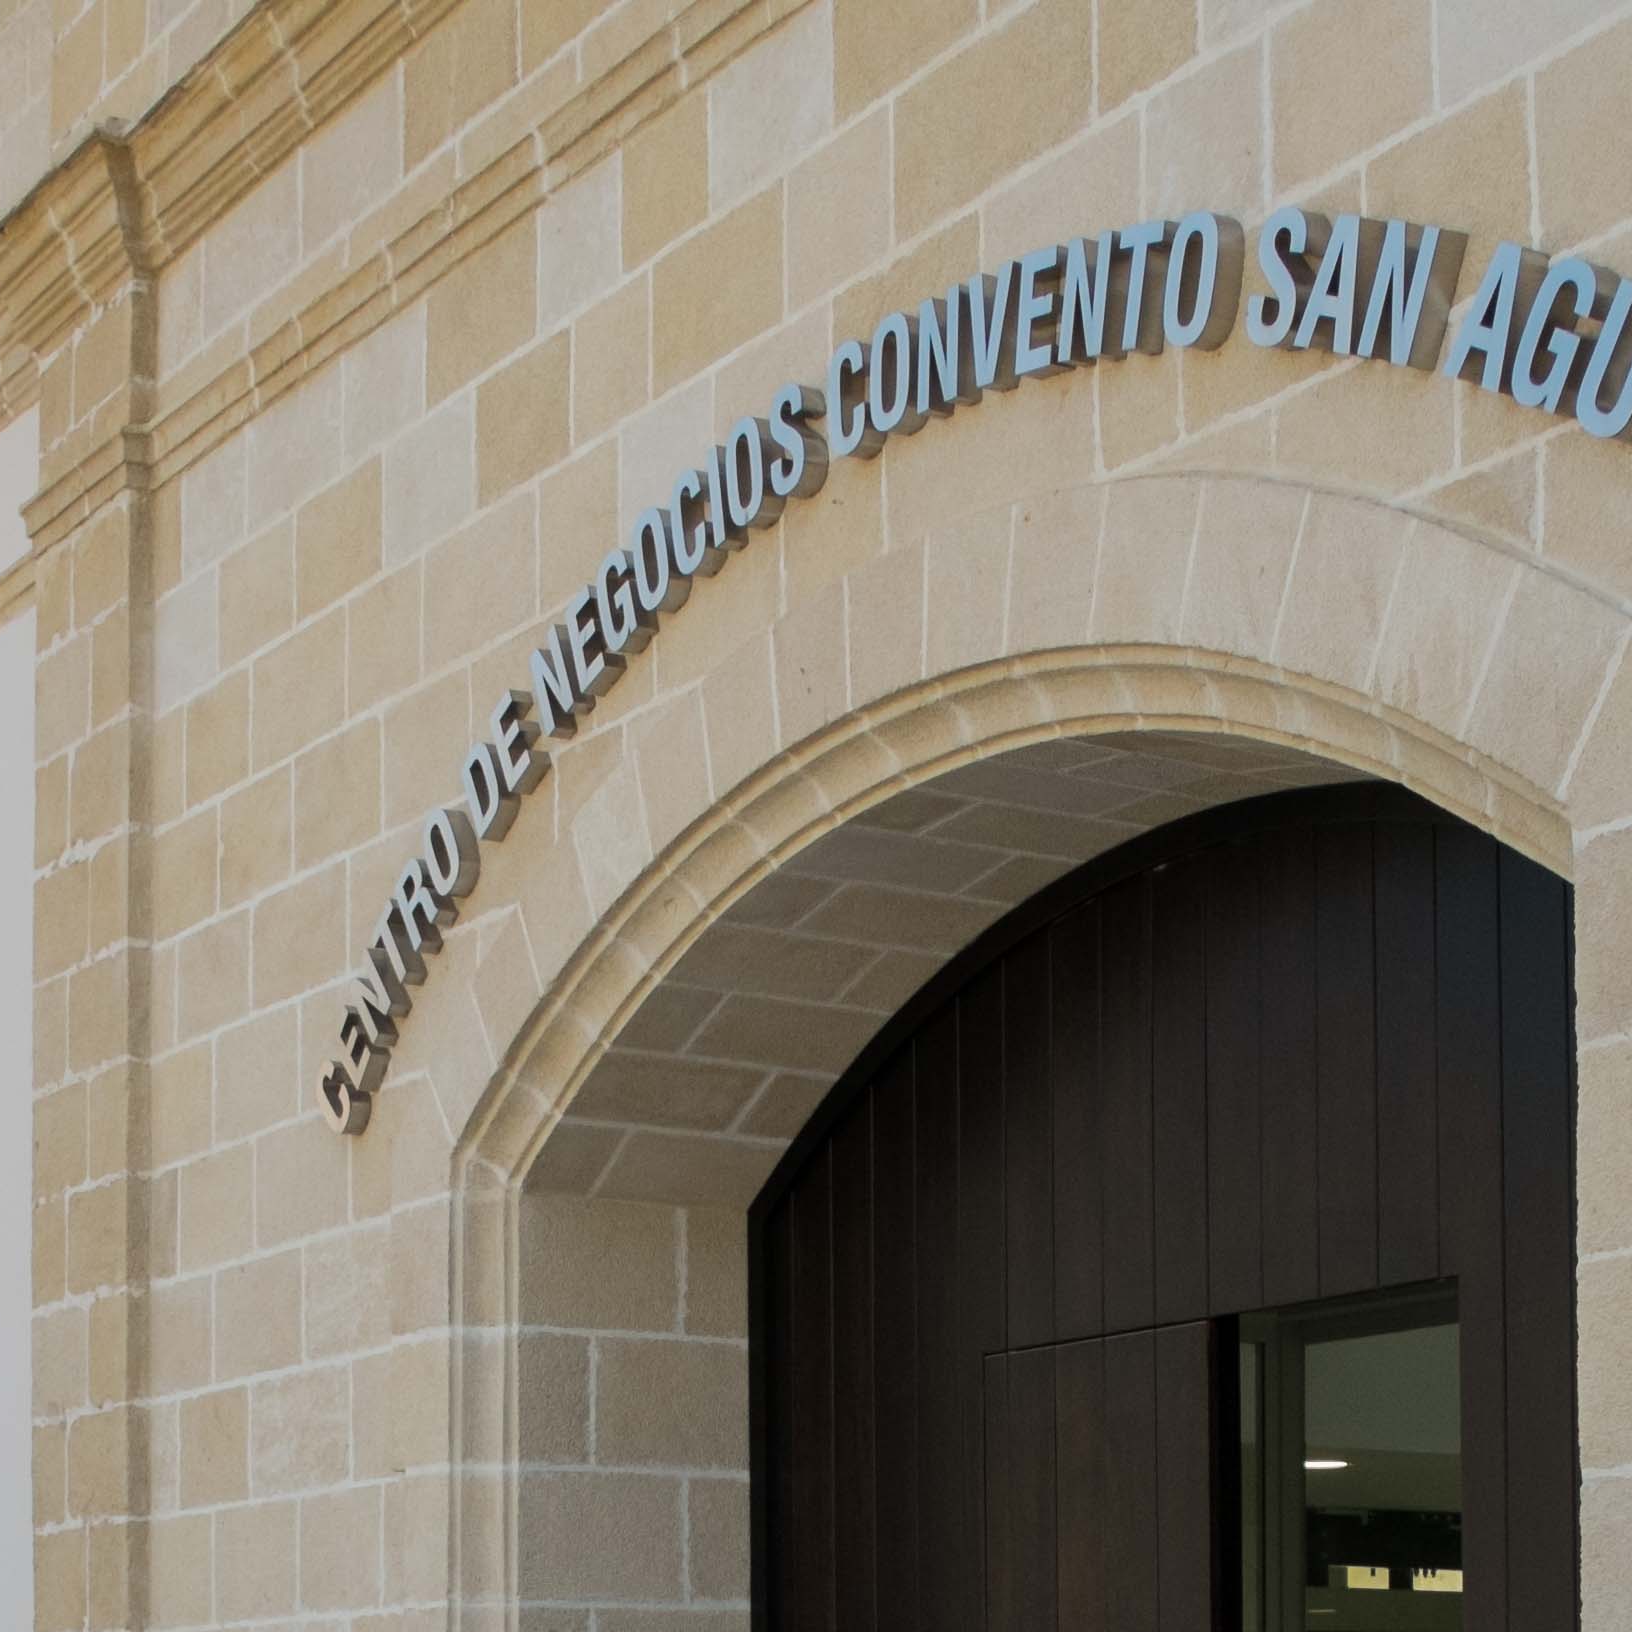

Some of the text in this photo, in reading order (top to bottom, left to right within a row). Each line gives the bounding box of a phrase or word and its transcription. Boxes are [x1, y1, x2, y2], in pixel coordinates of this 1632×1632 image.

[318, 808, 468, 1136] CENTRO
[464, 689, 538, 841] DE
[530, 383, 812, 738] NEGOCIOS
[828, 212, 1226, 457] CONVENTO
[1245, 207, 1448, 369] SAN
